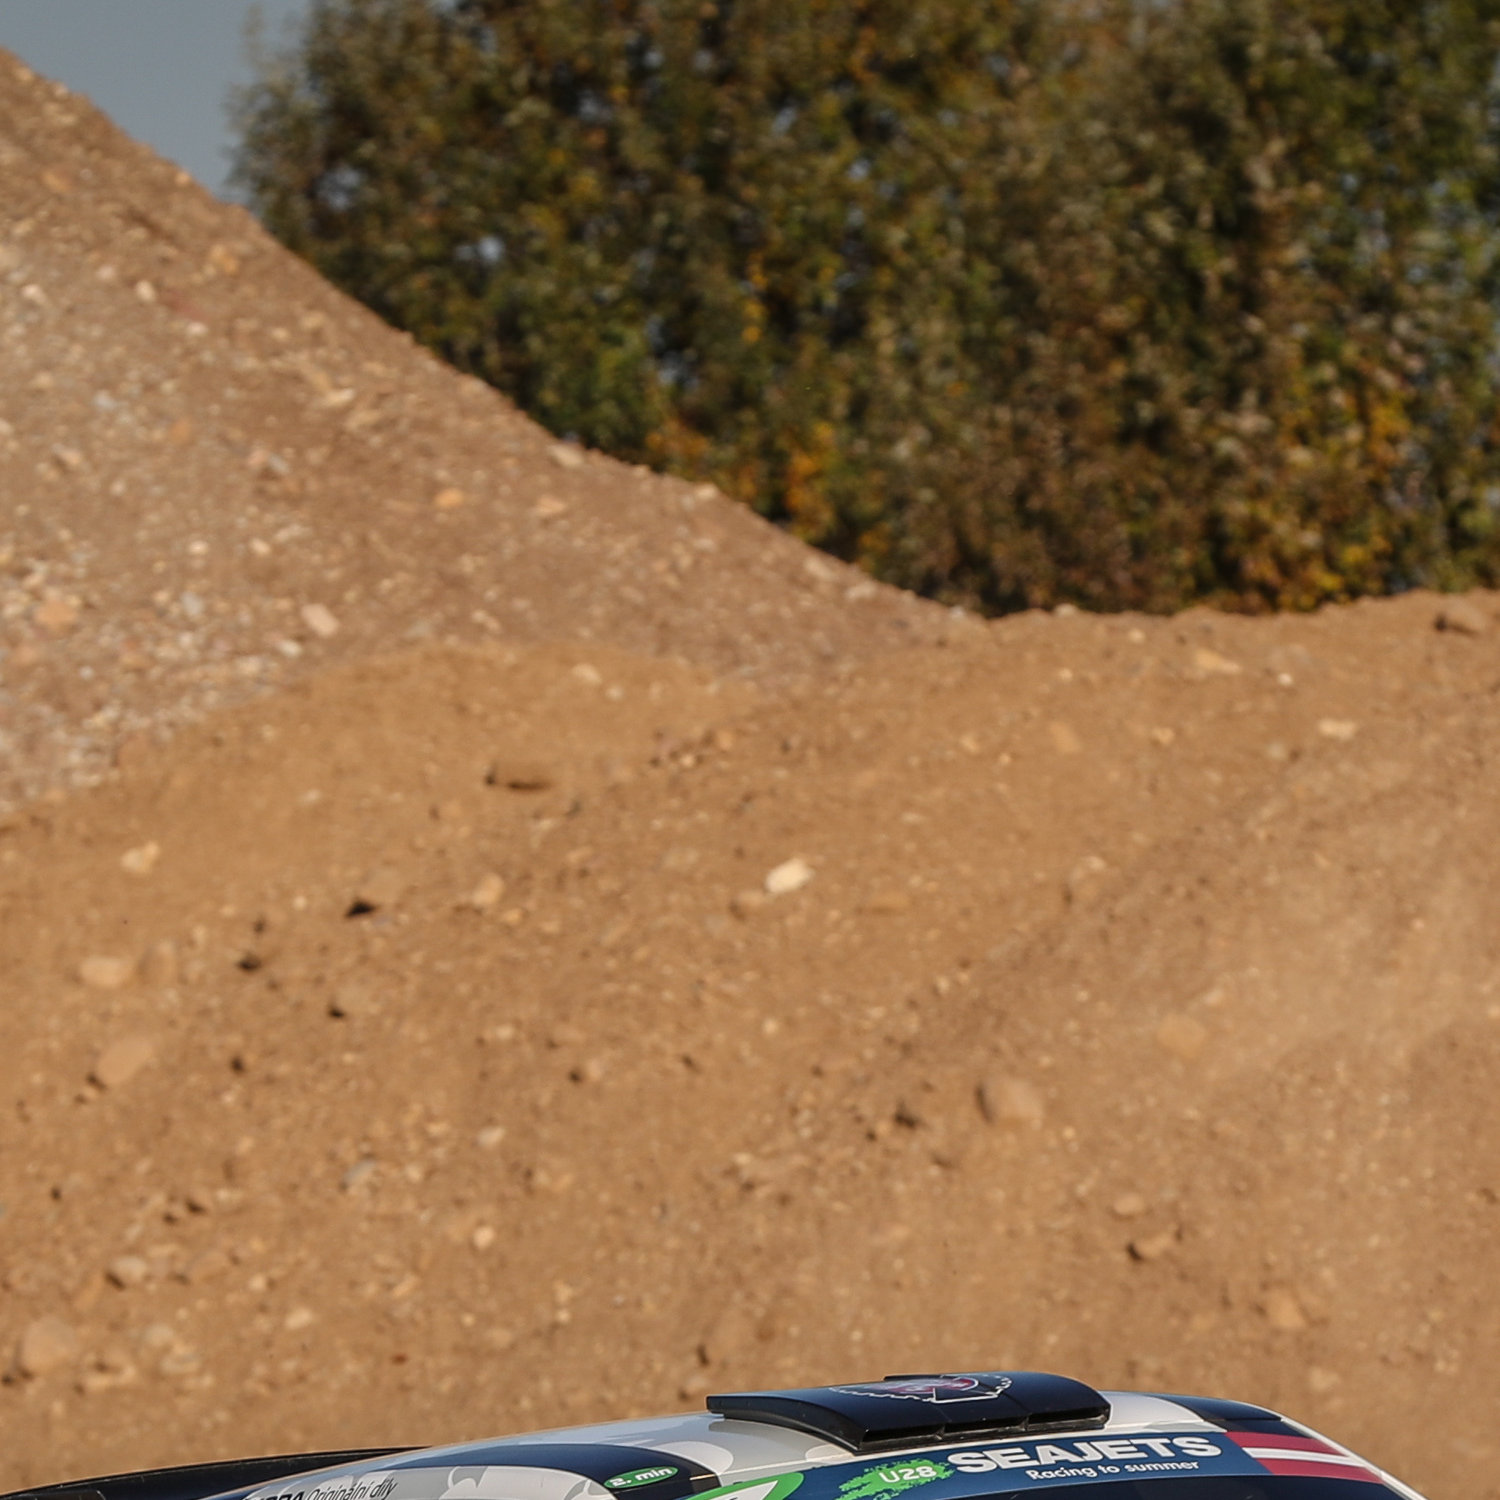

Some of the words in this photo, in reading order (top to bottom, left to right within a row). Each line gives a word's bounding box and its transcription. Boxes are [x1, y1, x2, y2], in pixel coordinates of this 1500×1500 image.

[947, 1436, 1222, 1474] SEAJETS
[635, 1466, 673, 1482] min
[879, 1464, 938, 1483] U28
[1025, 1464, 1097, 1481] Racing
[1099, 1463, 1120, 1475] to
[1123, 1461, 1200, 1473] summer
